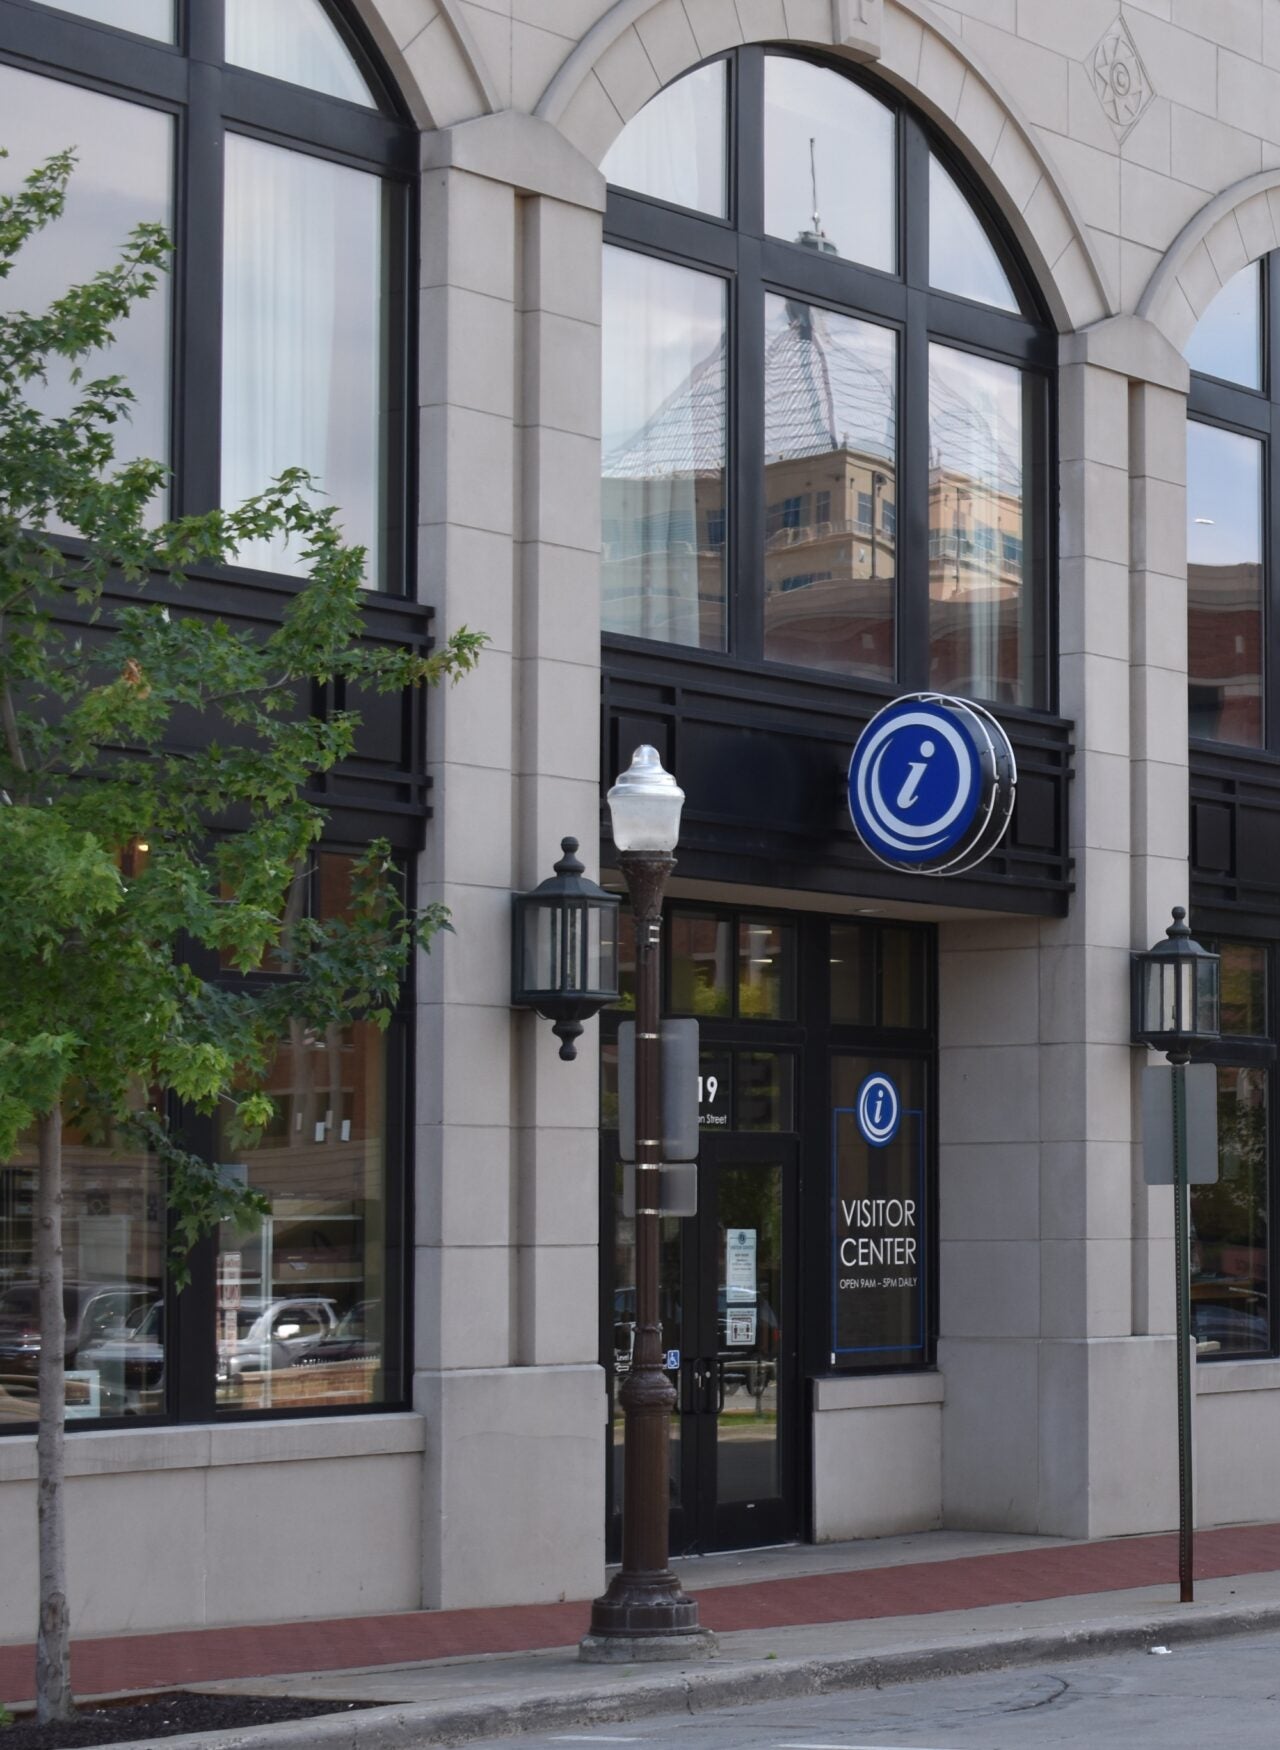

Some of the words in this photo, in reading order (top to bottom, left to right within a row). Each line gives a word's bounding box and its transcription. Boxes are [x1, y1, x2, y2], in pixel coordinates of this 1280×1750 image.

[706, 1113, 727, 1125] Street
[841, 1199, 916, 1227] VISITOR
[840, 1238, 917, 1266] CENTER
[840, 1279, 860, 1289] OPEN
[860, 1279, 877, 1288] 9AM
[882, 1278, 898, 1288] 5PM
[898, 1277, 918, 1287] DAILY
